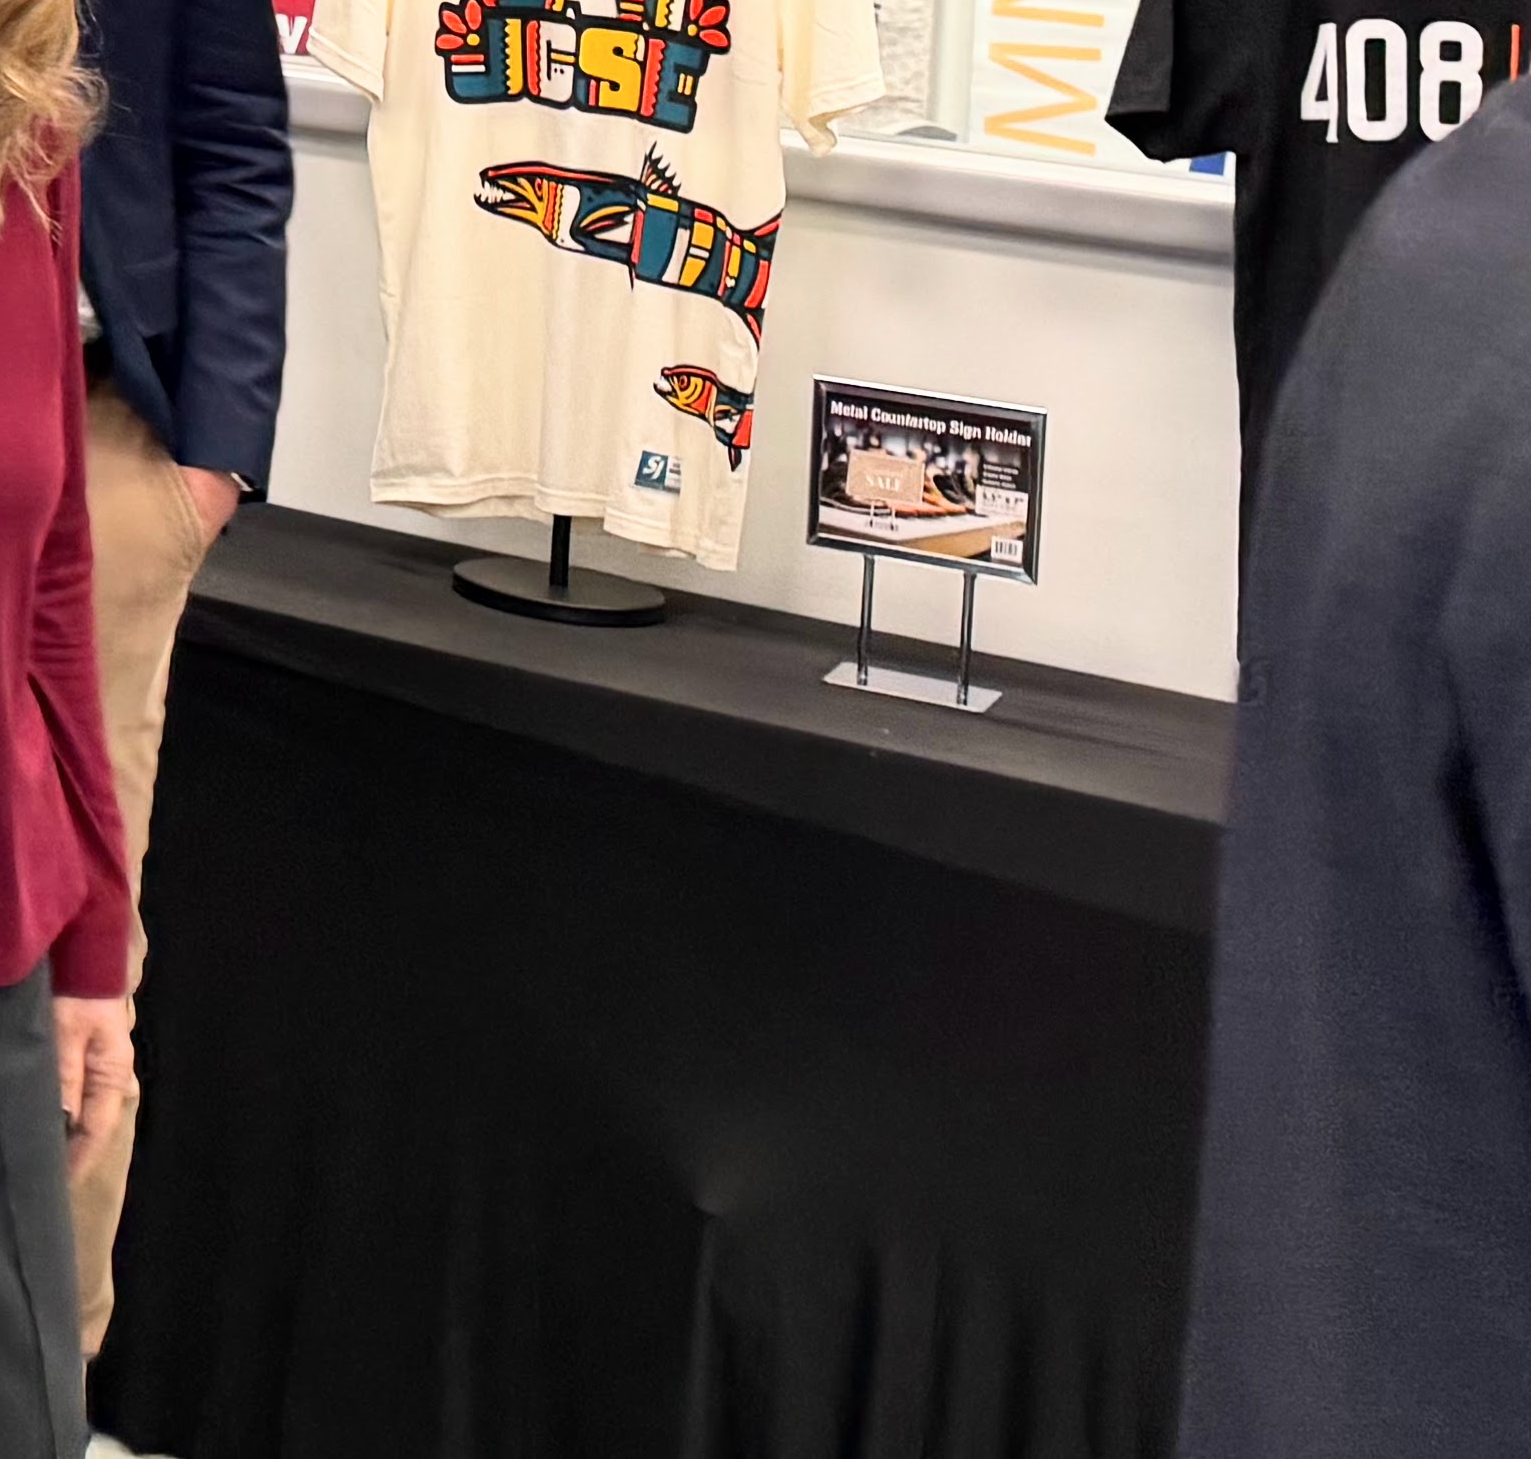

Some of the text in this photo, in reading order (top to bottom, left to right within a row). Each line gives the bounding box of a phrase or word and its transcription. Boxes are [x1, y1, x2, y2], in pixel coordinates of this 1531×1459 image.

[1300, 17, 1485, 144] 408
[830, 400, 1032, 449] Metal Countertop Sign Holder
